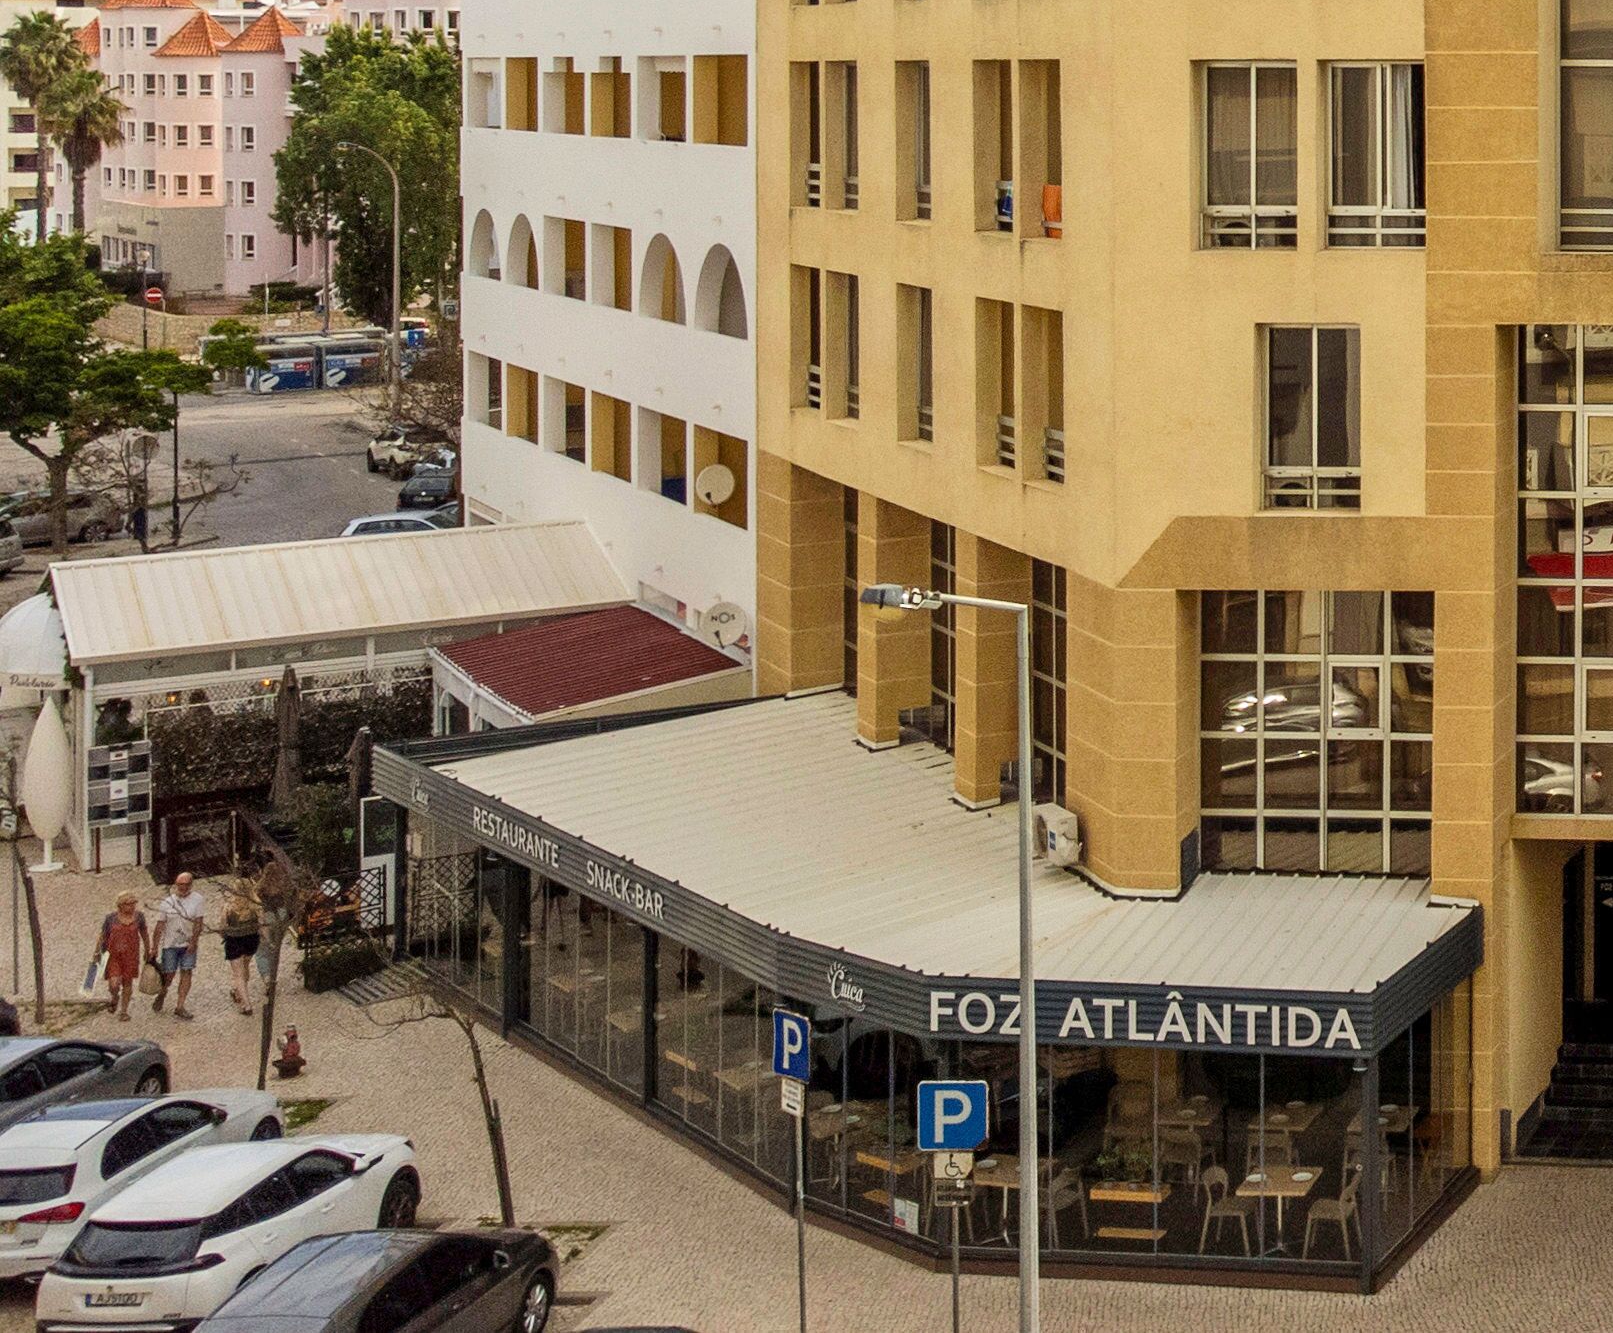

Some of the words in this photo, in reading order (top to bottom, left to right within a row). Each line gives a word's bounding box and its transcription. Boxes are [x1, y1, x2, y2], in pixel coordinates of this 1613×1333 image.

[472, 805, 560, 868] RESTAURANTE
[585, 859, 665, 920] SNACK-BAR
[782, 1019, 803, 1069] P
[929, 991, 1022, 1036] FOZ
[1058, 991, 1362, 1050] ATLÂNTIDA
[933, 1089, 973, 1144] P
